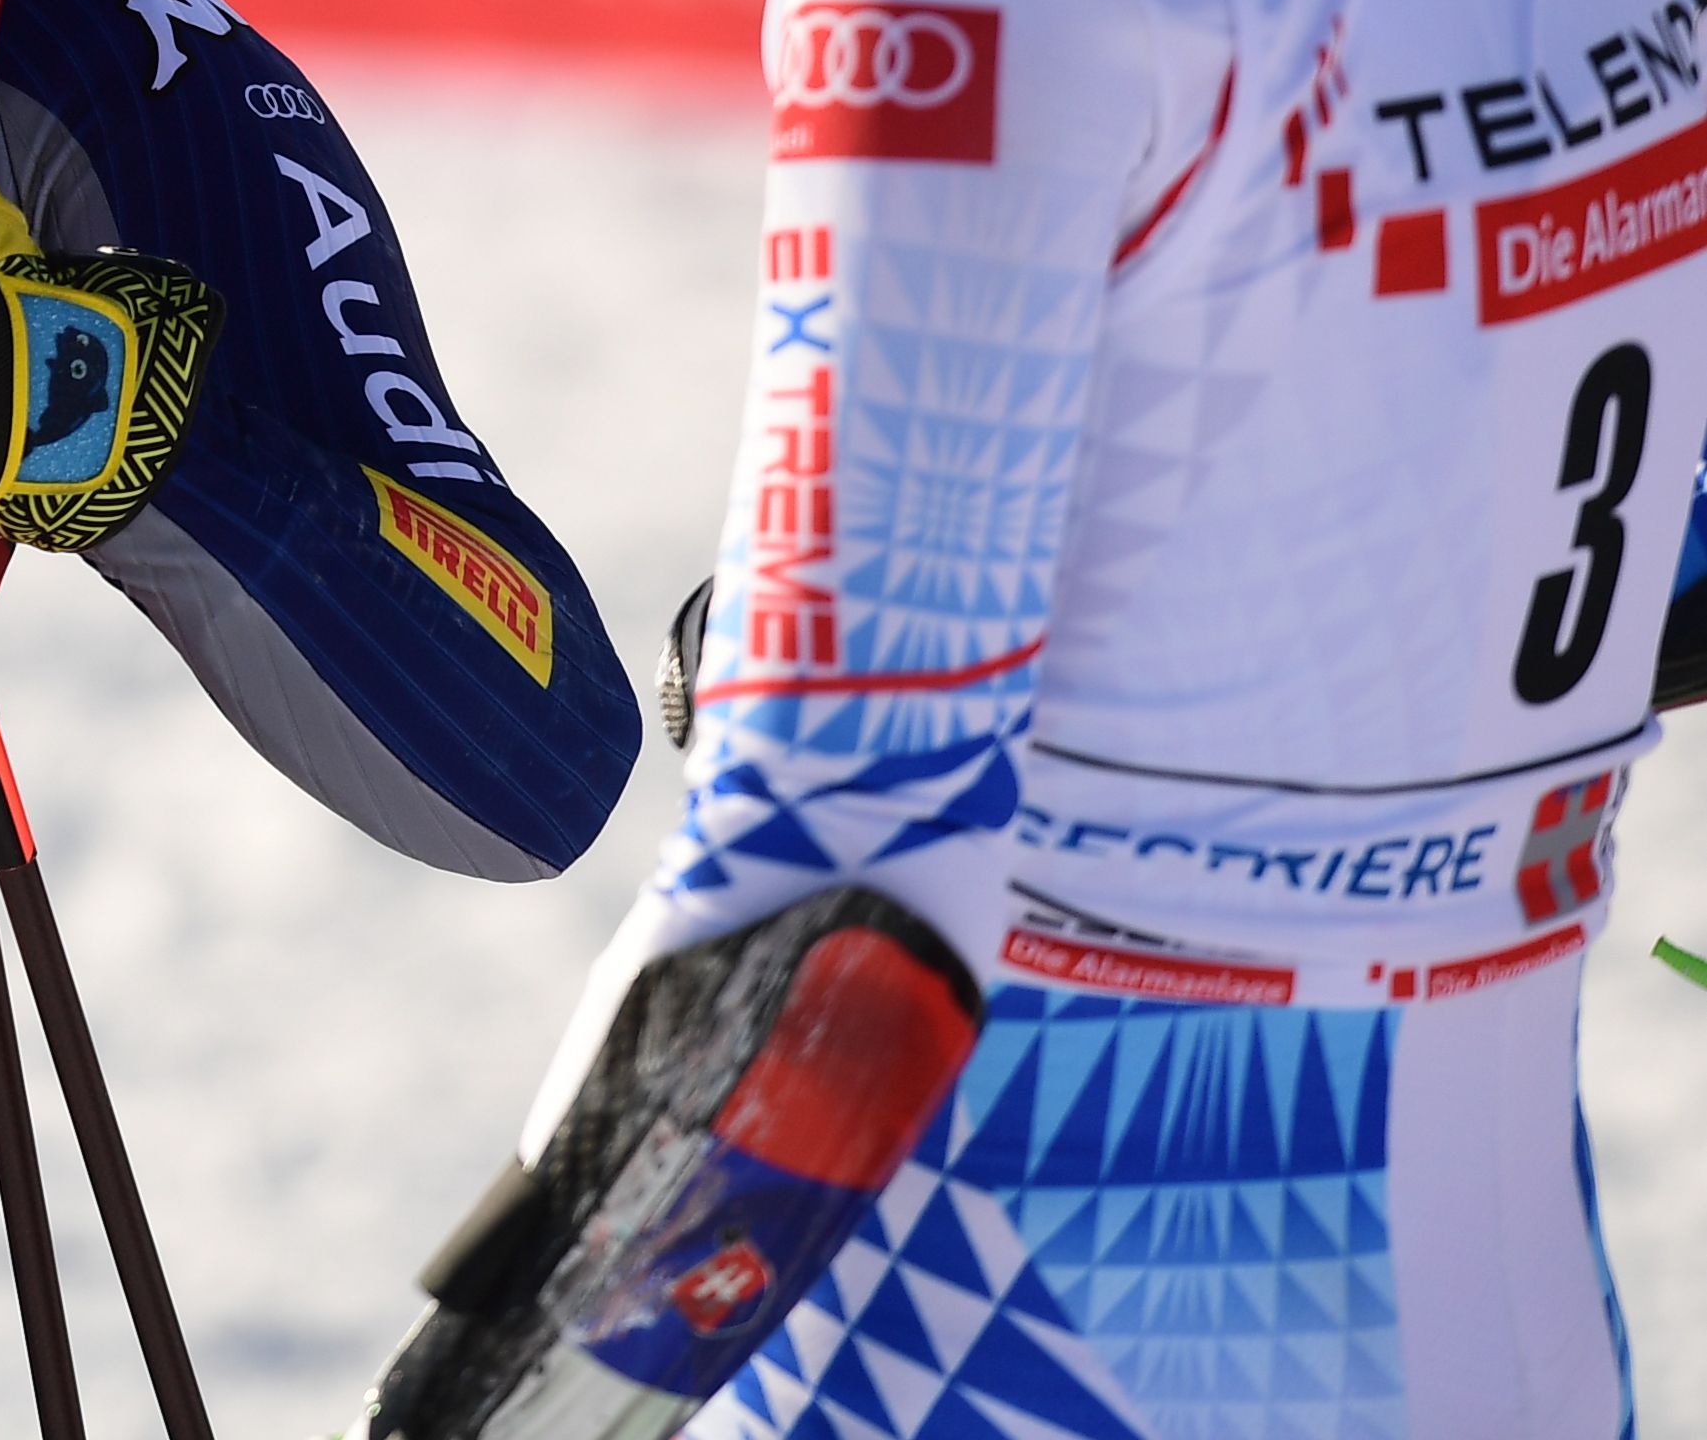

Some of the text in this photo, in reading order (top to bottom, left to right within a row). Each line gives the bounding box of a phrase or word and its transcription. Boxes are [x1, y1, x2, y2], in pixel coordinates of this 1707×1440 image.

[272, 152, 509, 490] Audi
[1496, 165, 1707, 298] Die Alarma
[388, 492, 540, 655] PIRELLI
[747, 224, 839, 670] EXTREME
[1511, 340, 1652, 707] 3
